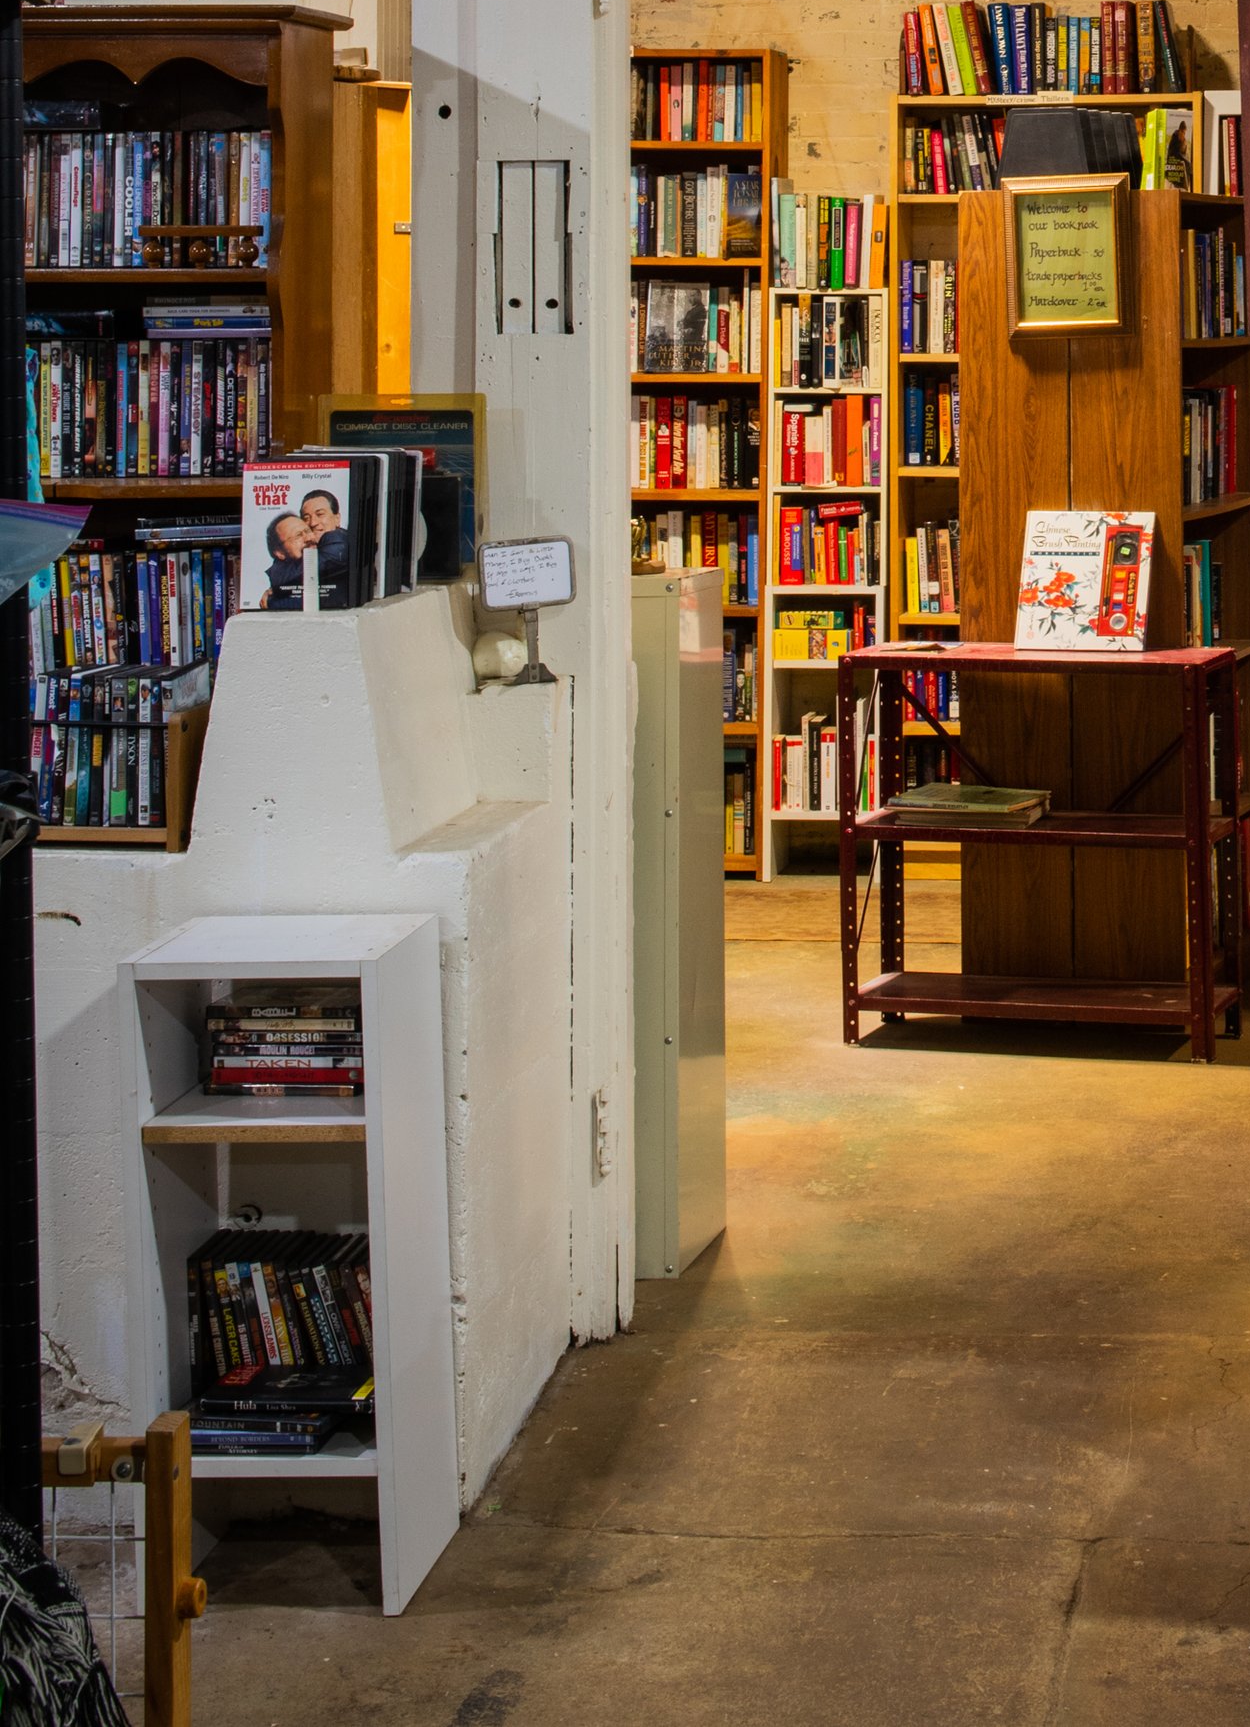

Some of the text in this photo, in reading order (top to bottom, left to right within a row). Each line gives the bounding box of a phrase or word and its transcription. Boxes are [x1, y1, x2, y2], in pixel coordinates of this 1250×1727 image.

[995, 6, 1003, 24] DAN
[1015, 7, 1026, 49] TOM CLANCY
[997, 27, 1006, 57] BROWN
[1091, 28, 1099, 73] JAMES PATTERSON
[135, 153, 143, 210] COURAGE UNDER
[84, 172, 92, 230] CARRIERS
[124, 176, 134, 236] COOLER
[684, 181, 695, 219] GOAT BROTHERS
[1026, 201, 1088, 216] Welcome to
[193, 371, 201, 436] STEAMBOY
[791, 414, 799, 446] Spanish
[925, 404, 934, 452] CHANEL
[253, 483, 290, 493] analyze
[255, 492, 288, 506] that
[705, 514, 715, 565] MY TURN
[1035, 520, 1072, 535] Chinese
[1032, 535, 1102, 551] Brush Painting
[83, 592, 91, 618] ORANGE
[48, 678, 56, 709] almost
[127, 735, 135, 766] TYSON
[245, 1059, 312, 1068] TAKEN
[301, 1301, 320, 1350] RESERVATION
[228, 1340, 241, 1365] CAKE
[266, 1334, 277, 1359] LAMBS
[233, 1400, 257, 1412] Hula
[240, 1435, 272, 1443] BORDERS
